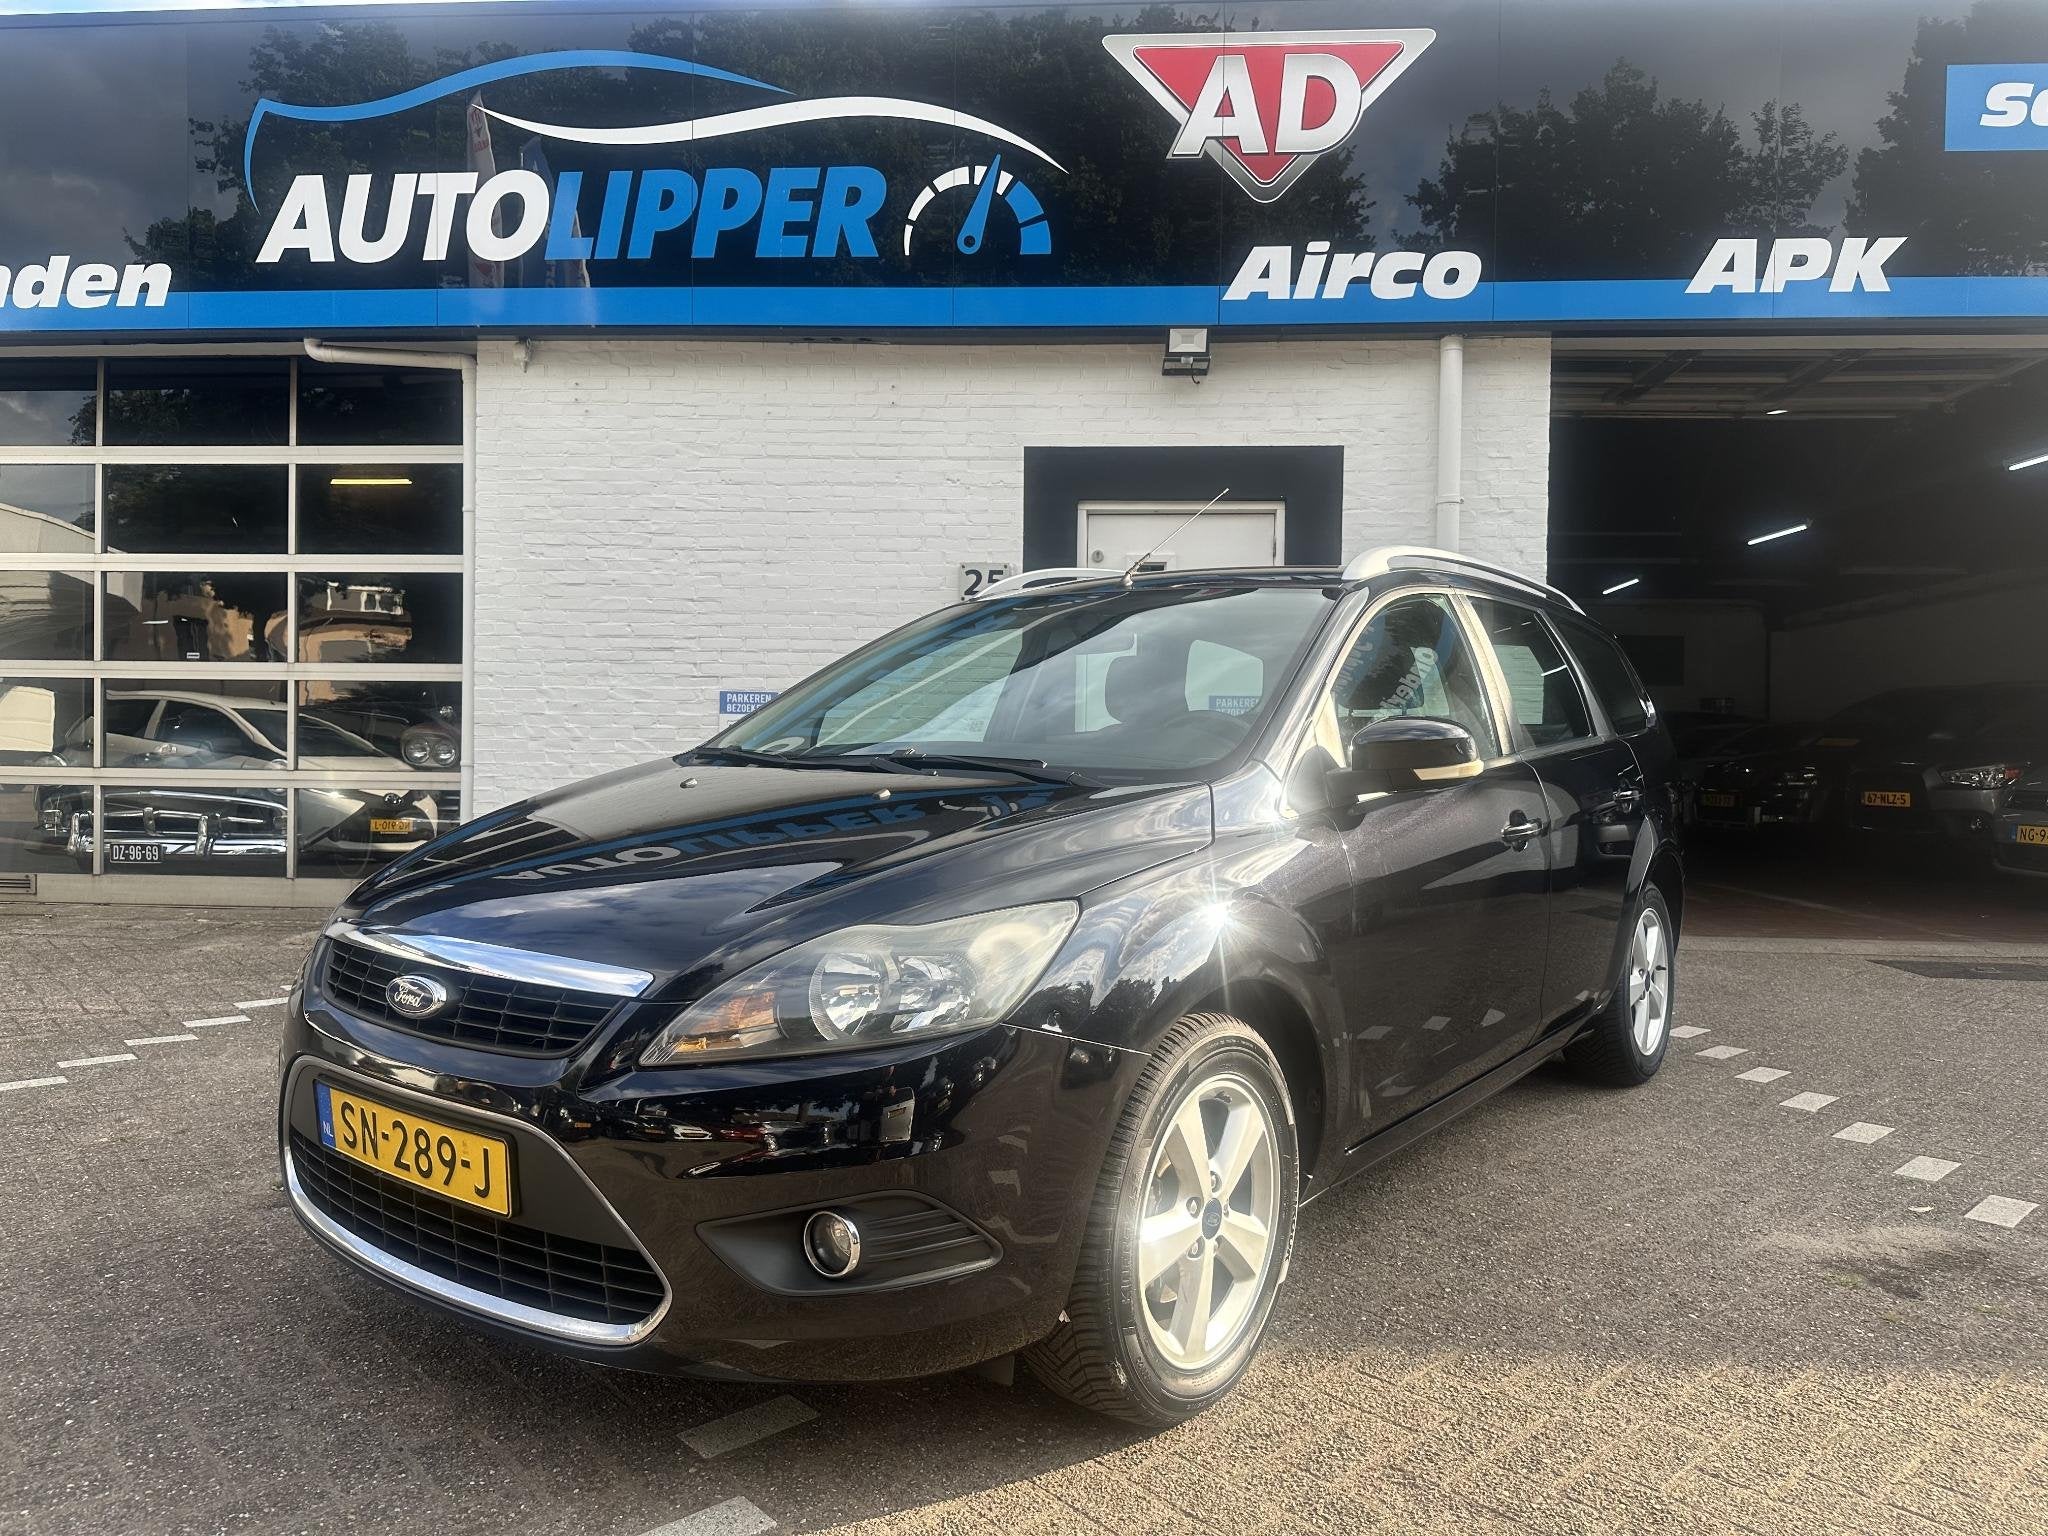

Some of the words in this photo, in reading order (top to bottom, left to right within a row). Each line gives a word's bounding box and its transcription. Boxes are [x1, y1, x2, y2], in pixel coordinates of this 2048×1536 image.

[1169, 53, 1362, 157] AD
[256, 165, 887, 264] AUTOLIPPER
[0, 255, 173, 309] den
[1222, 240, 1482, 301] Airco
[1684, 236, 1908, 294] APK
[726, 693, 772, 704] PARKEREN
[112, 845, 159, 860] DZ-96-69
[2020, 828, 2048, 842] NG-9
[394, 981, 425, 1008] Ford
[322, 1121, 334, 1138] NL
[340, 1101, 491, 1199] SN-289-J
